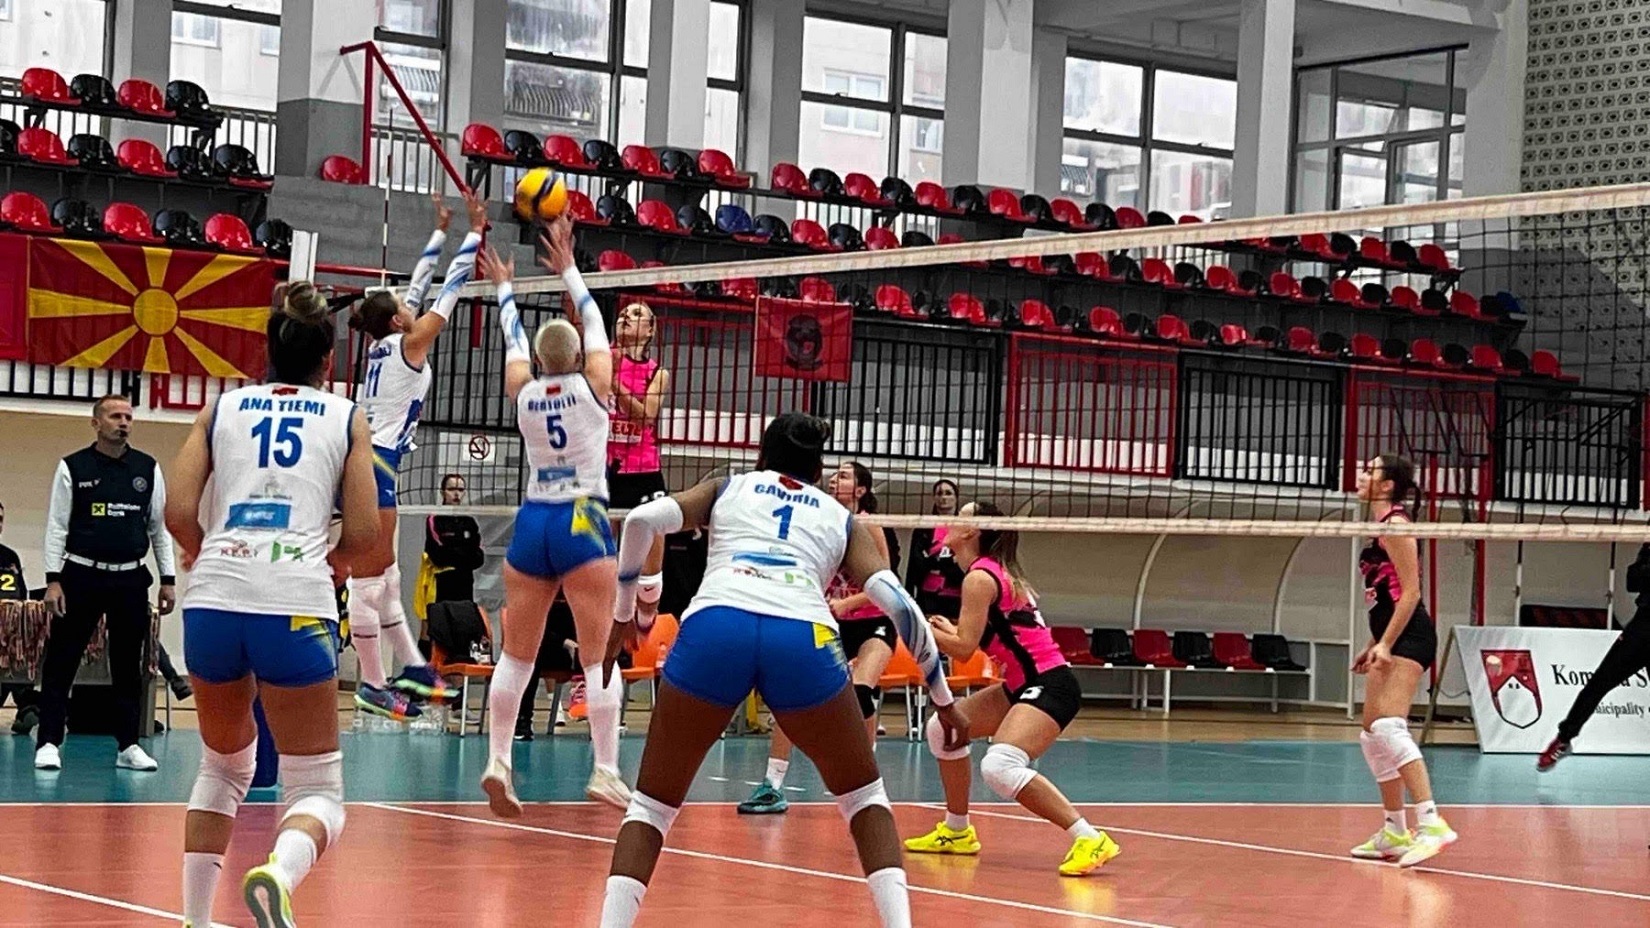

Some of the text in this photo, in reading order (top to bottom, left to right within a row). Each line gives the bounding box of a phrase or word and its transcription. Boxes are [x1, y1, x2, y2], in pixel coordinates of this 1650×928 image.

[239, 397, 326, 416] ANA TIEMI
[251, 416, 304, 468] 15
[546, 414, 567, 449] 5
[772, 504, 794, 540] 1
[0, 574, 16, 591] 2
[1551, 664, 1631, 688] Koma
